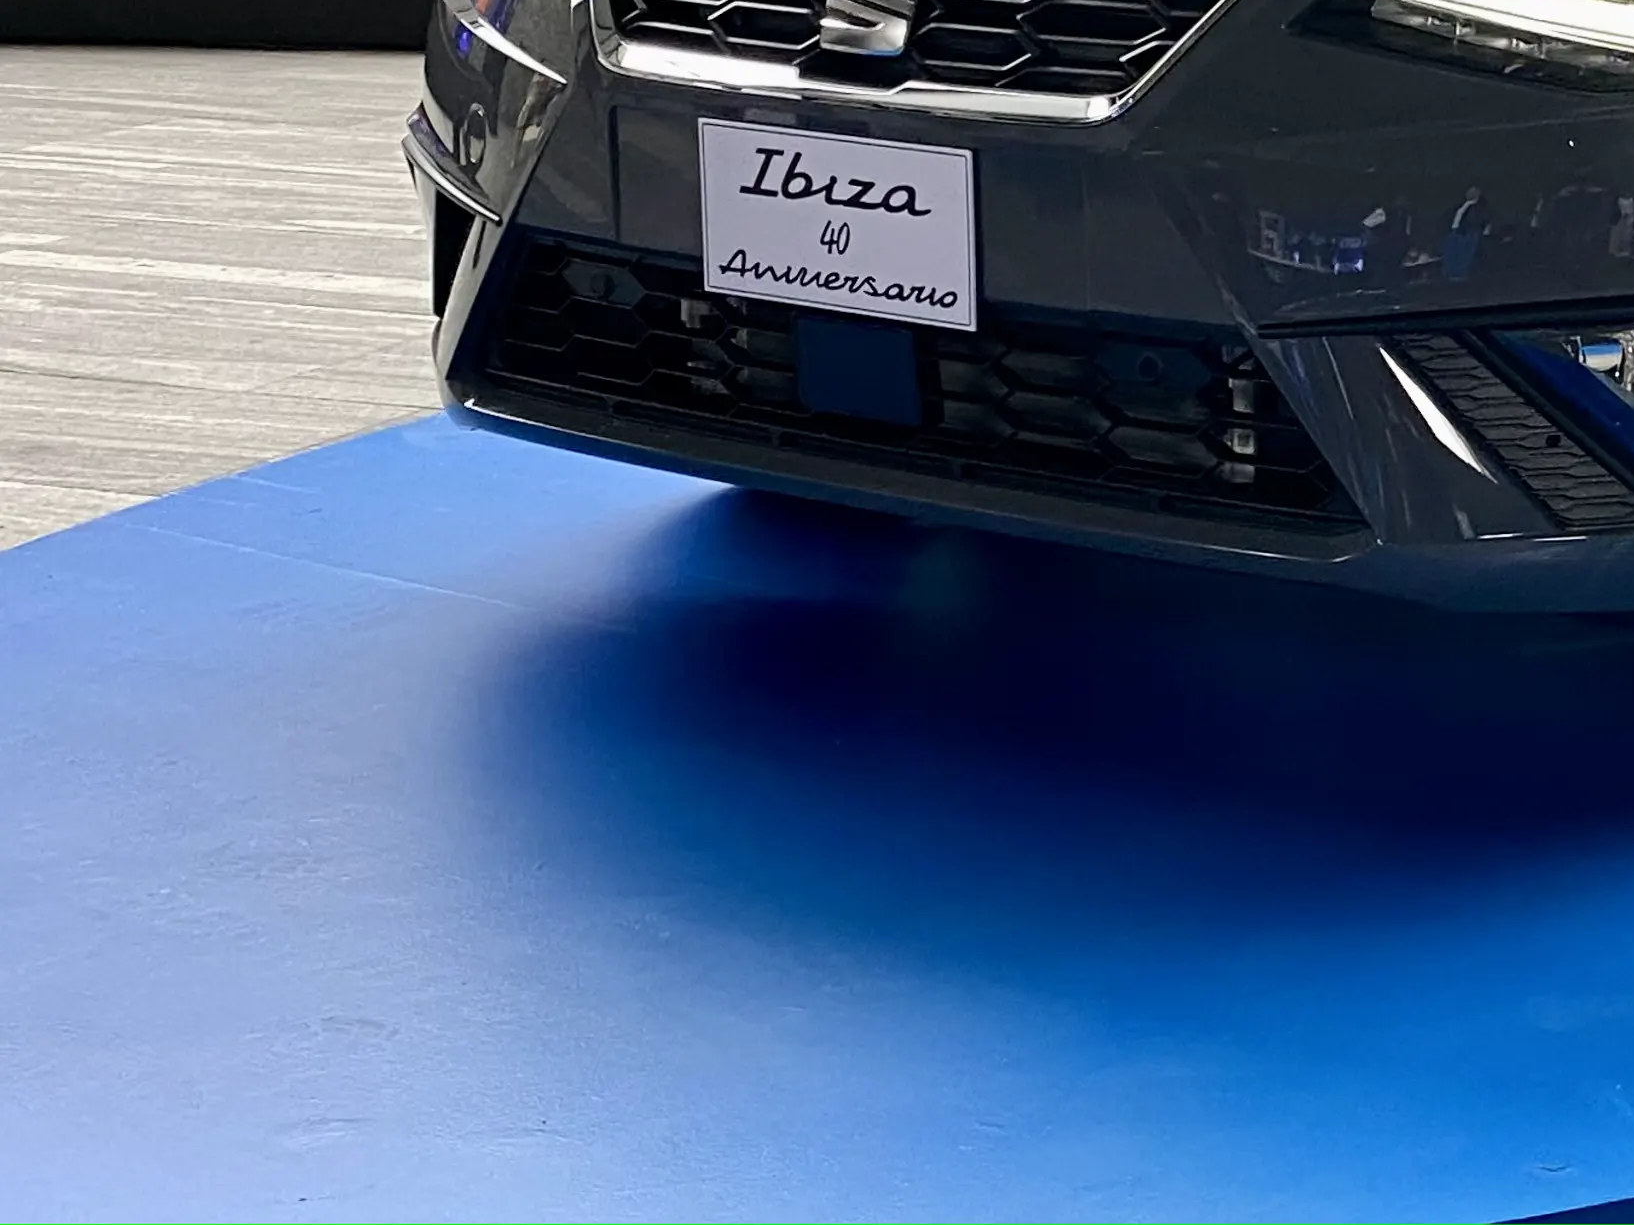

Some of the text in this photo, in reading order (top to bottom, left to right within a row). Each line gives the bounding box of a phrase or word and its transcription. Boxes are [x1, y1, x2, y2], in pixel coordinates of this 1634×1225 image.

[738, 147, 932, 217] Ibiza
[819, 220, 851, 256] 40
[718, 249, 959, 308] Aniversario
